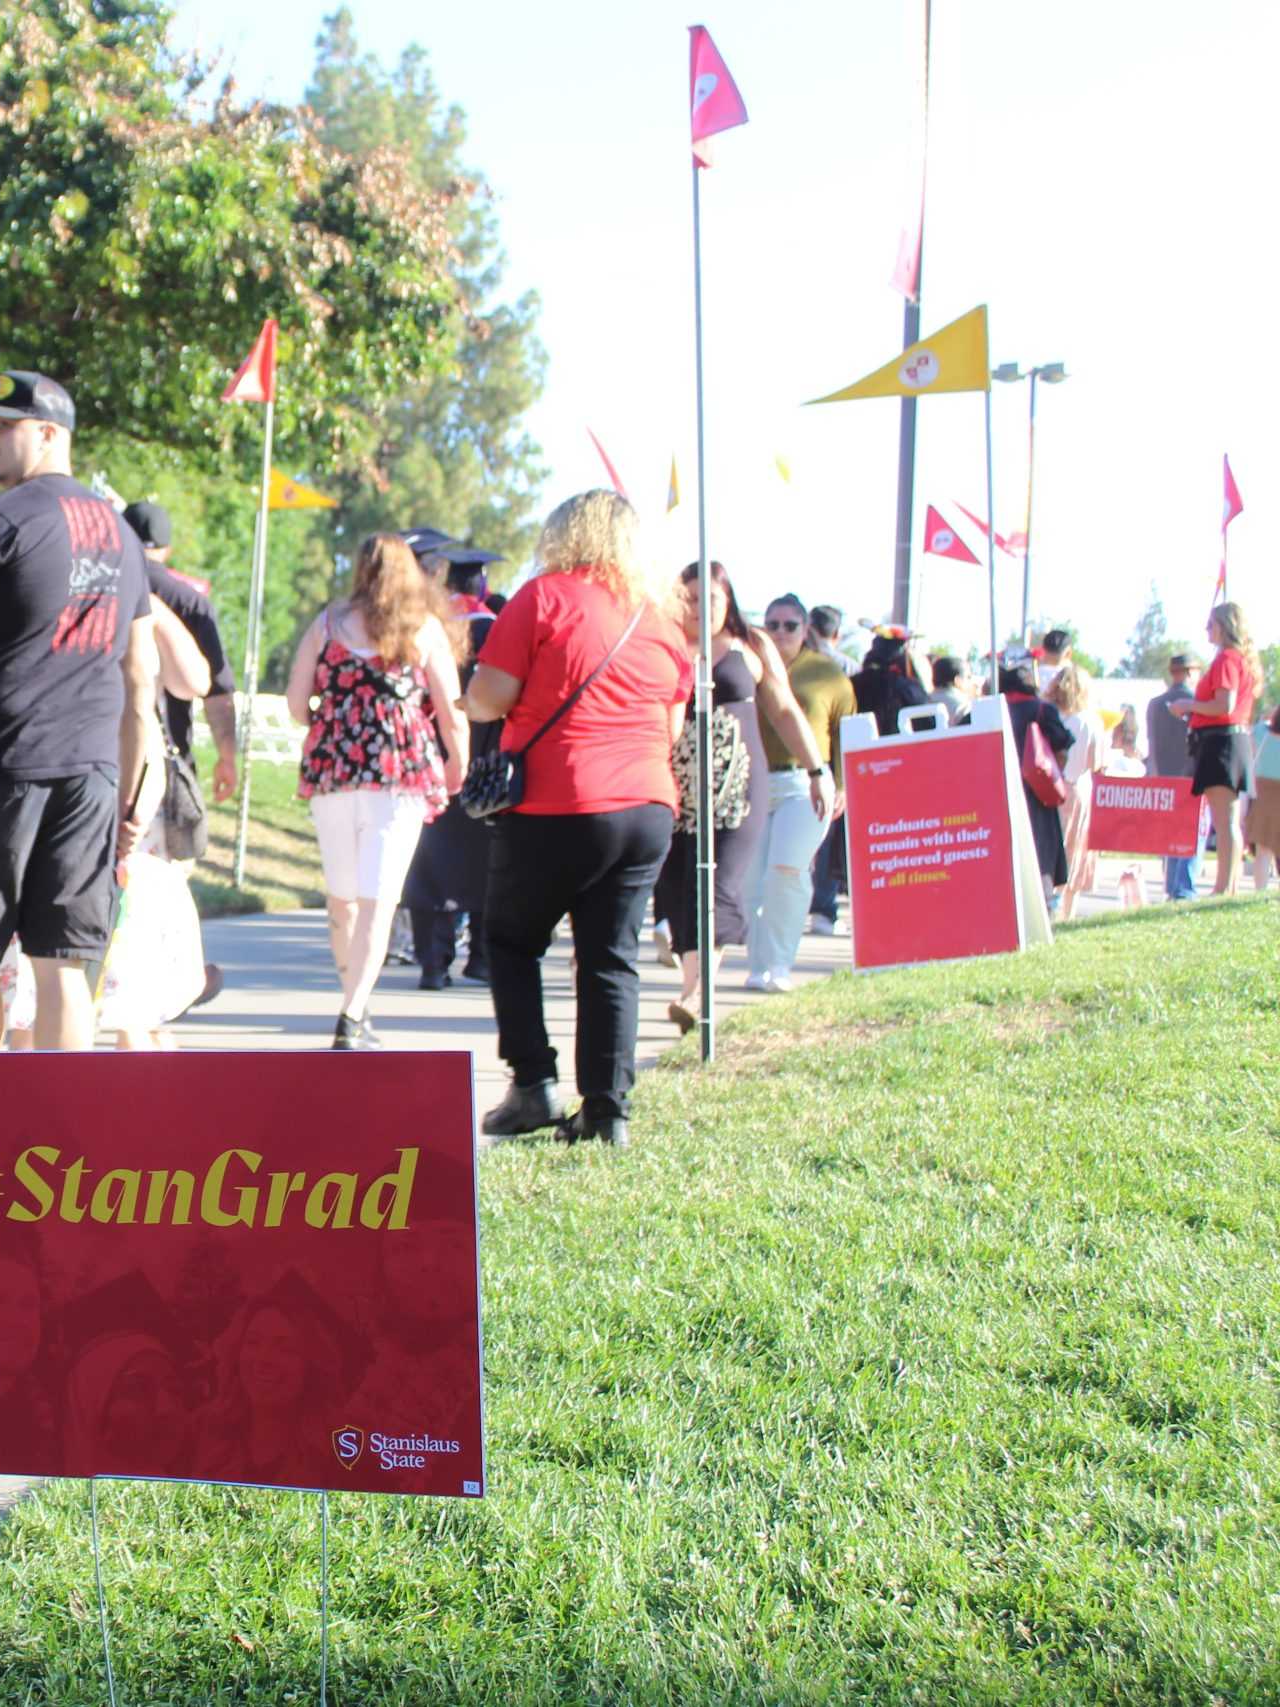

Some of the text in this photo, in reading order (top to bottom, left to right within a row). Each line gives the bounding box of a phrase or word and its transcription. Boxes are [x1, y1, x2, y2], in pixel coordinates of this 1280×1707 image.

[1096, 785, 1175, 811] CONGRATS!
[868, 811, 977, 836] Graduates must
[869, 827, 991, 854] remain with their
[870, 847, 989, 873] registered guests
[871, 877, 885, 889] at
[888, 872, 906, 888] all
[370, 1433, 460, 1453] Stanislaus
[380, 1451, 425, 1470] State
